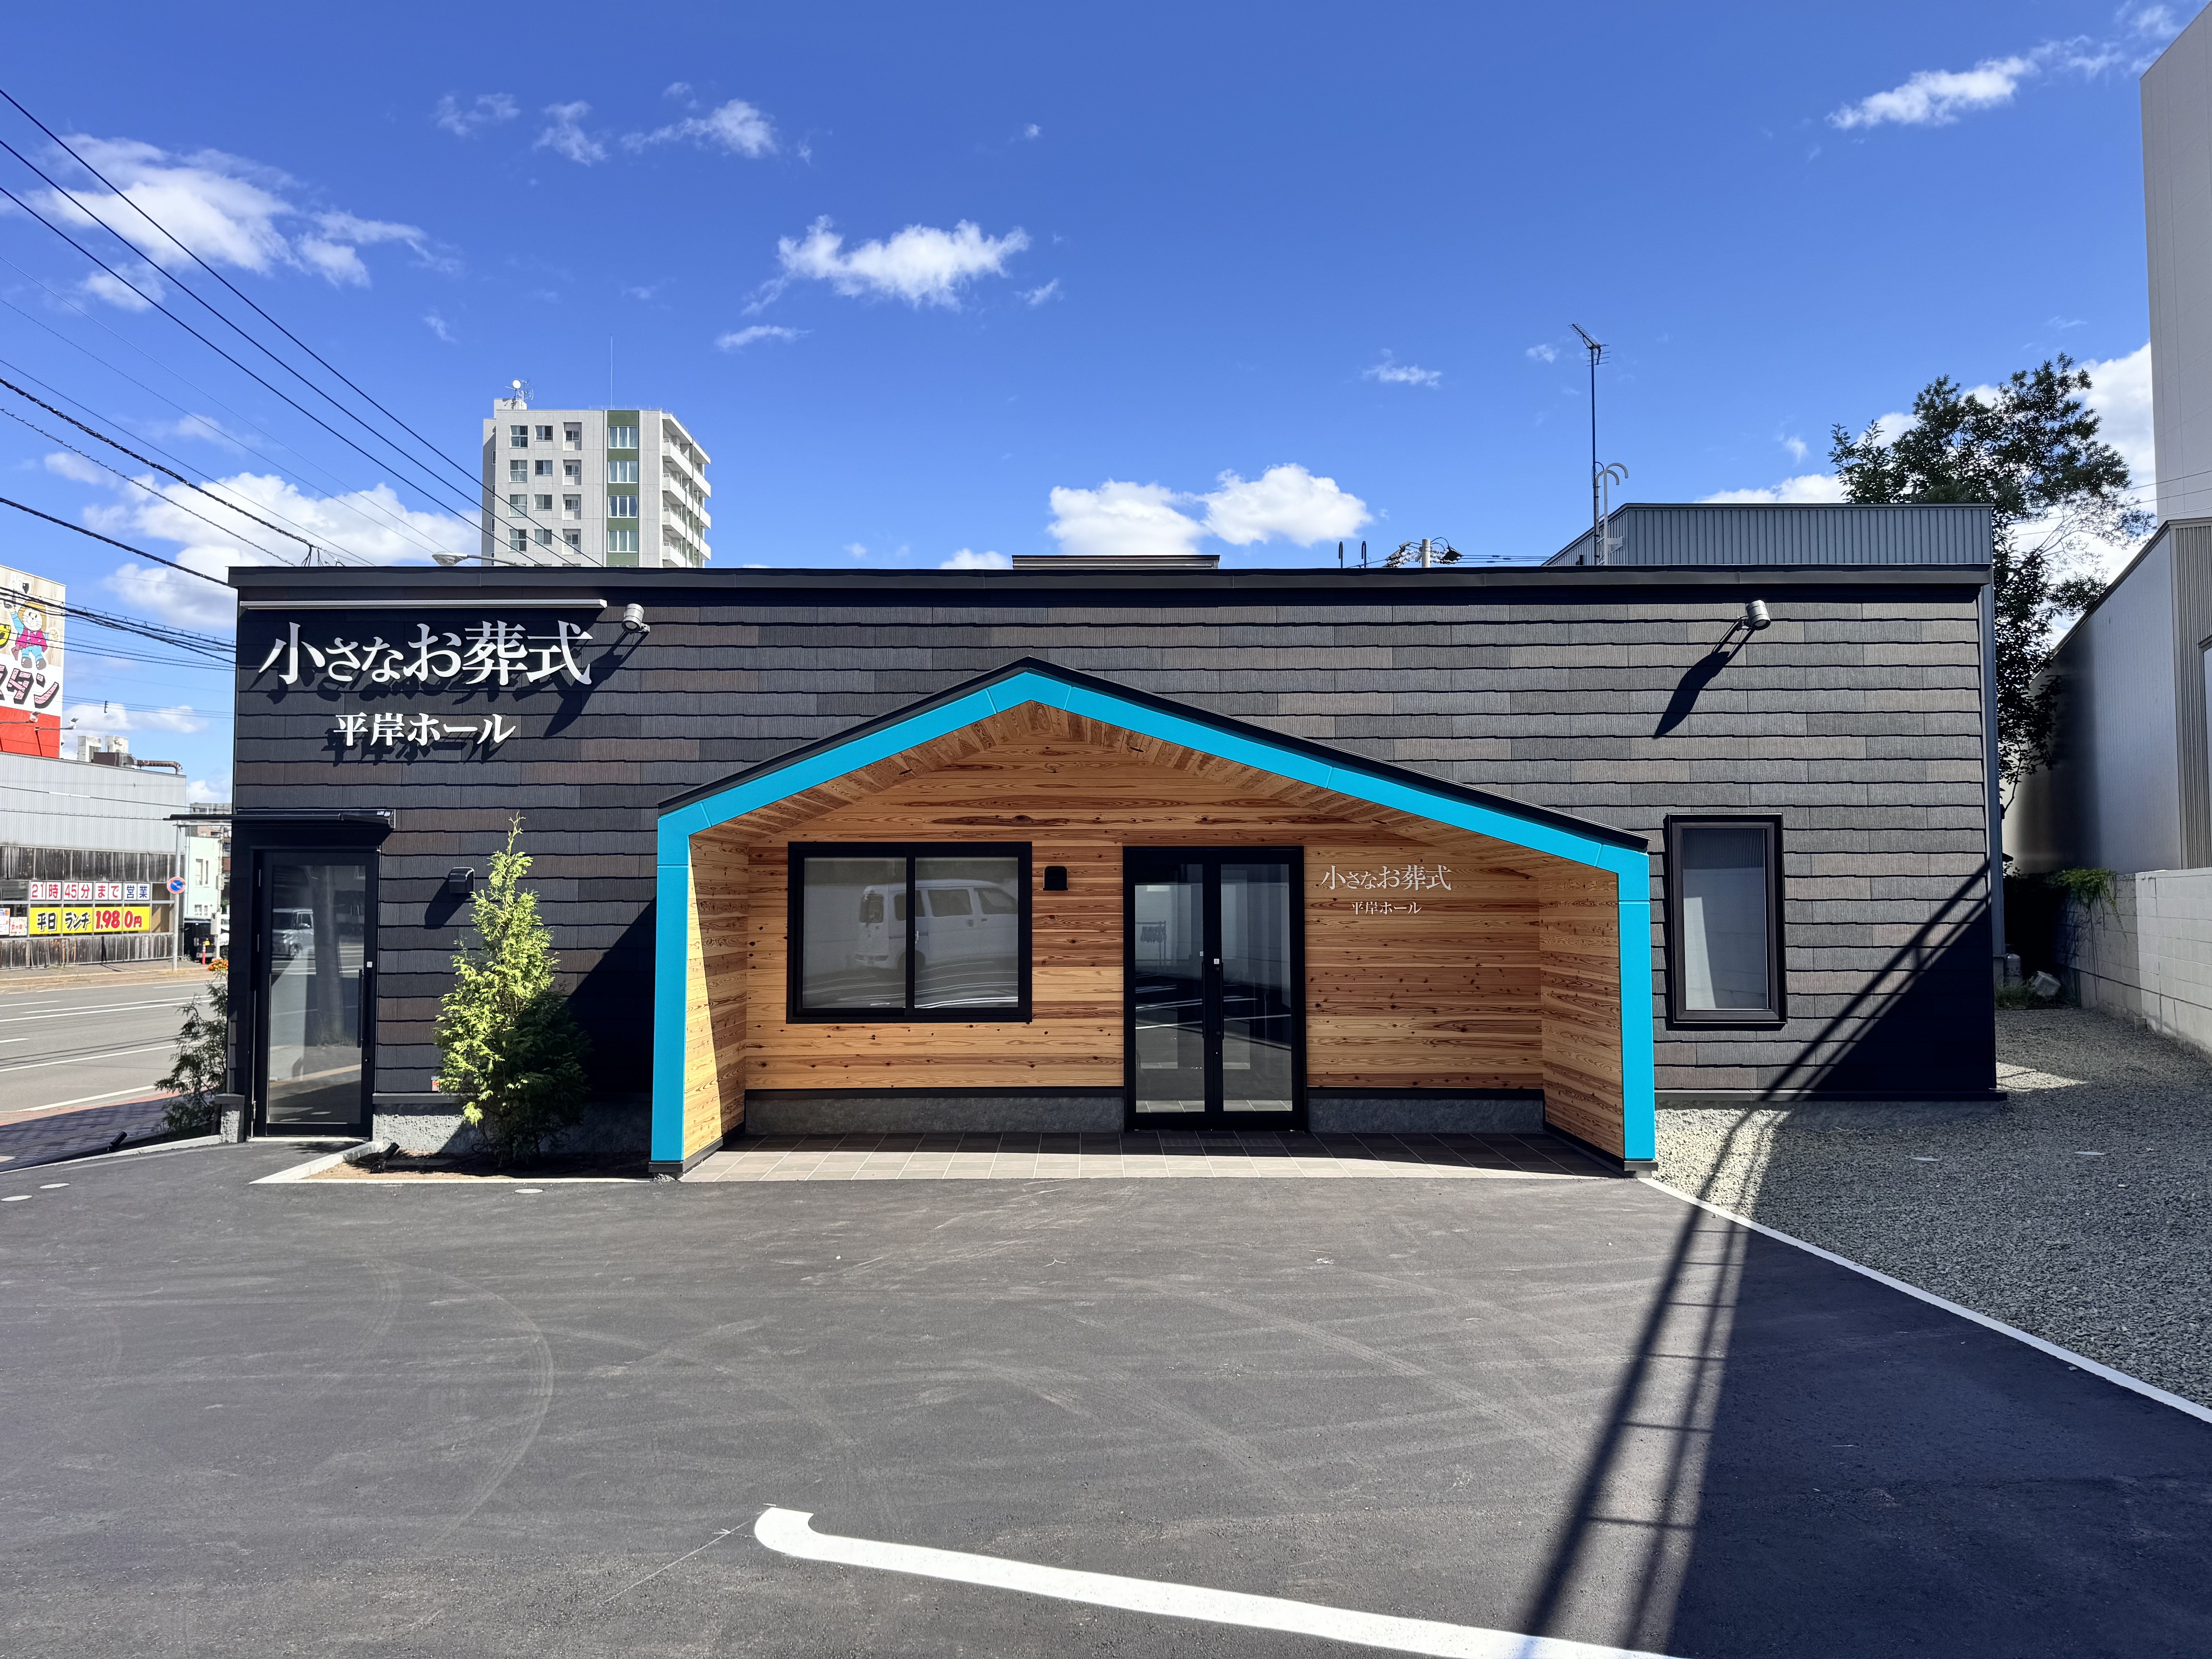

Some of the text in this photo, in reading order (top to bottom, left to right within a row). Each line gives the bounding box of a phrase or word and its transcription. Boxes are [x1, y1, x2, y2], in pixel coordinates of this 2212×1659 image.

[258, 620, 593, 685] 小さなお葬式
[333, 712, 516, 746] 平岸ホール
[32, 883, 148, 898] 21時45分まで営業
[1321, 864, 1452, 891] 小さなお葬式
[1350, 901, 1422, 915] 平岸ホール
